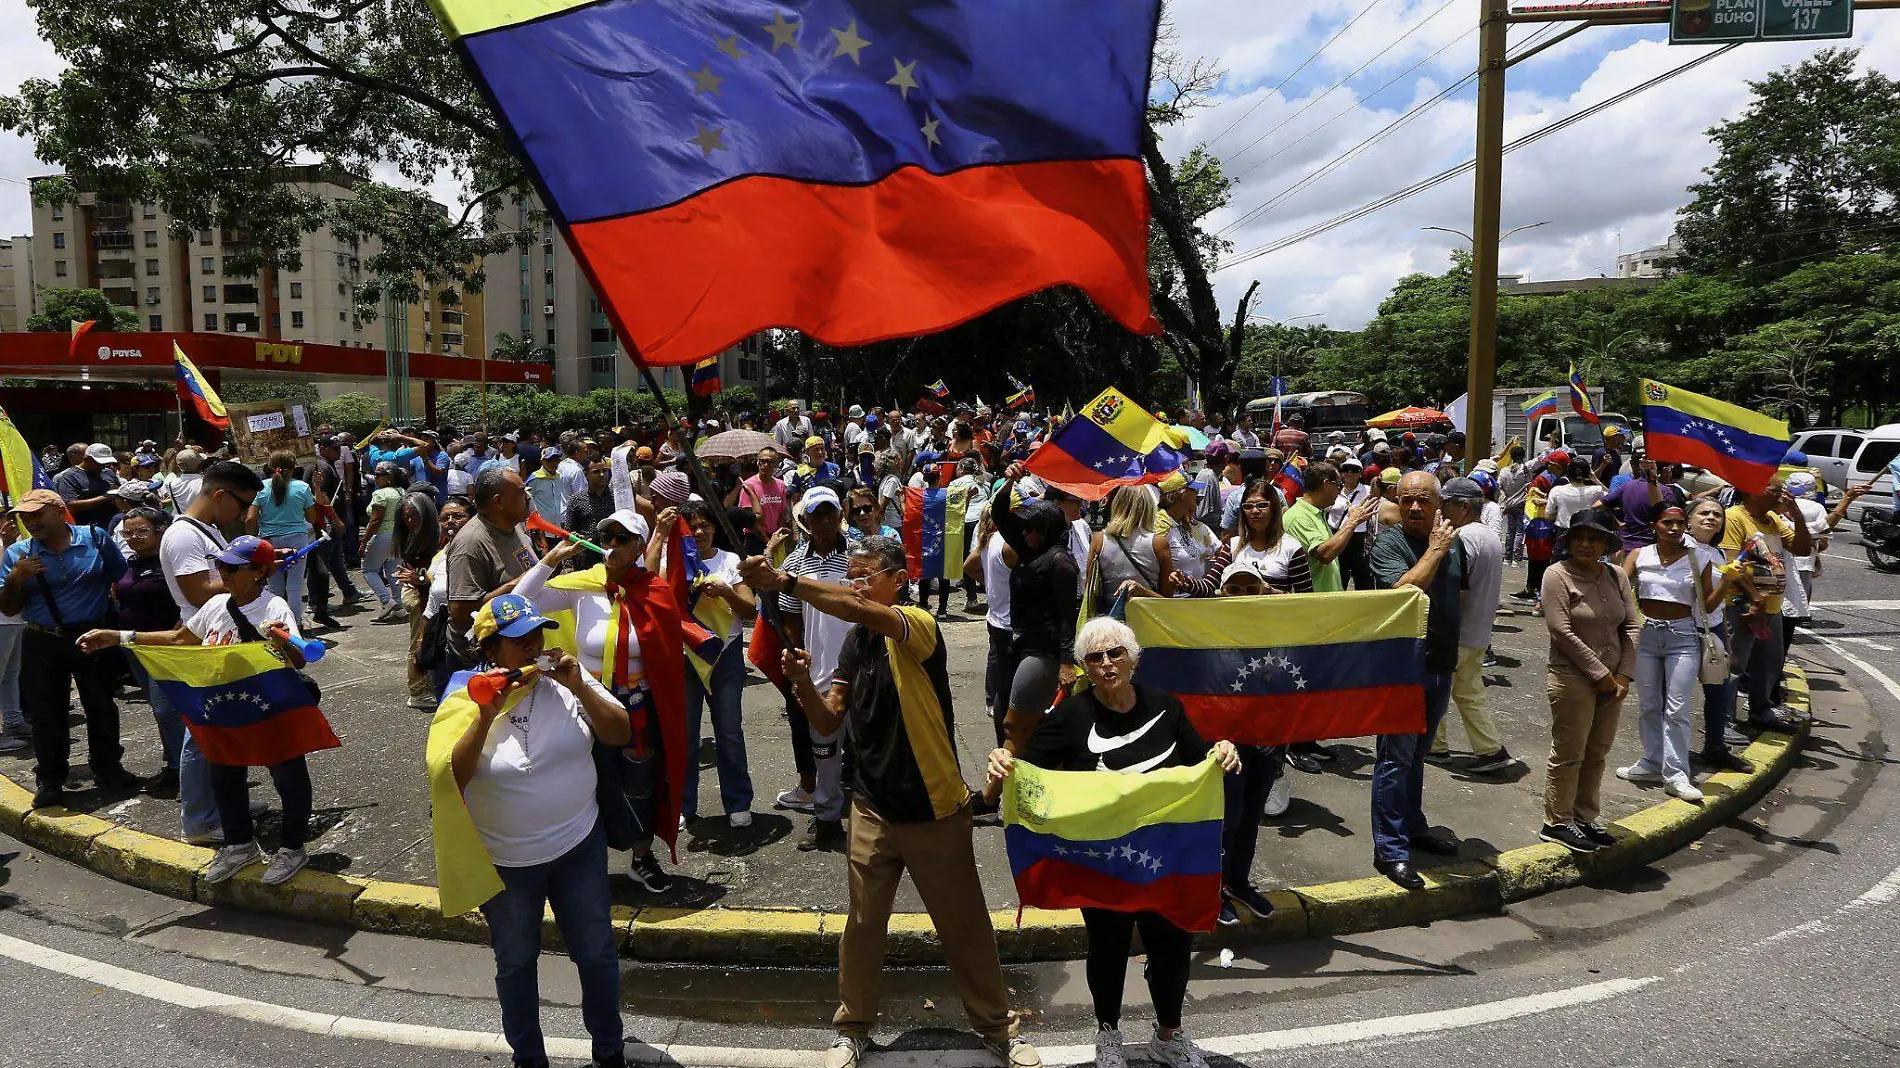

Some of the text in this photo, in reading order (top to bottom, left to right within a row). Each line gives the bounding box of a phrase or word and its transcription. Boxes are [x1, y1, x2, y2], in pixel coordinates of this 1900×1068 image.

[1716, 0, 1755, 9] PLAN
[1792, 8, 1821, 30] 137
[112, 349, 142, 357] PDVSA
[256, 342, 303, 364] PDV
